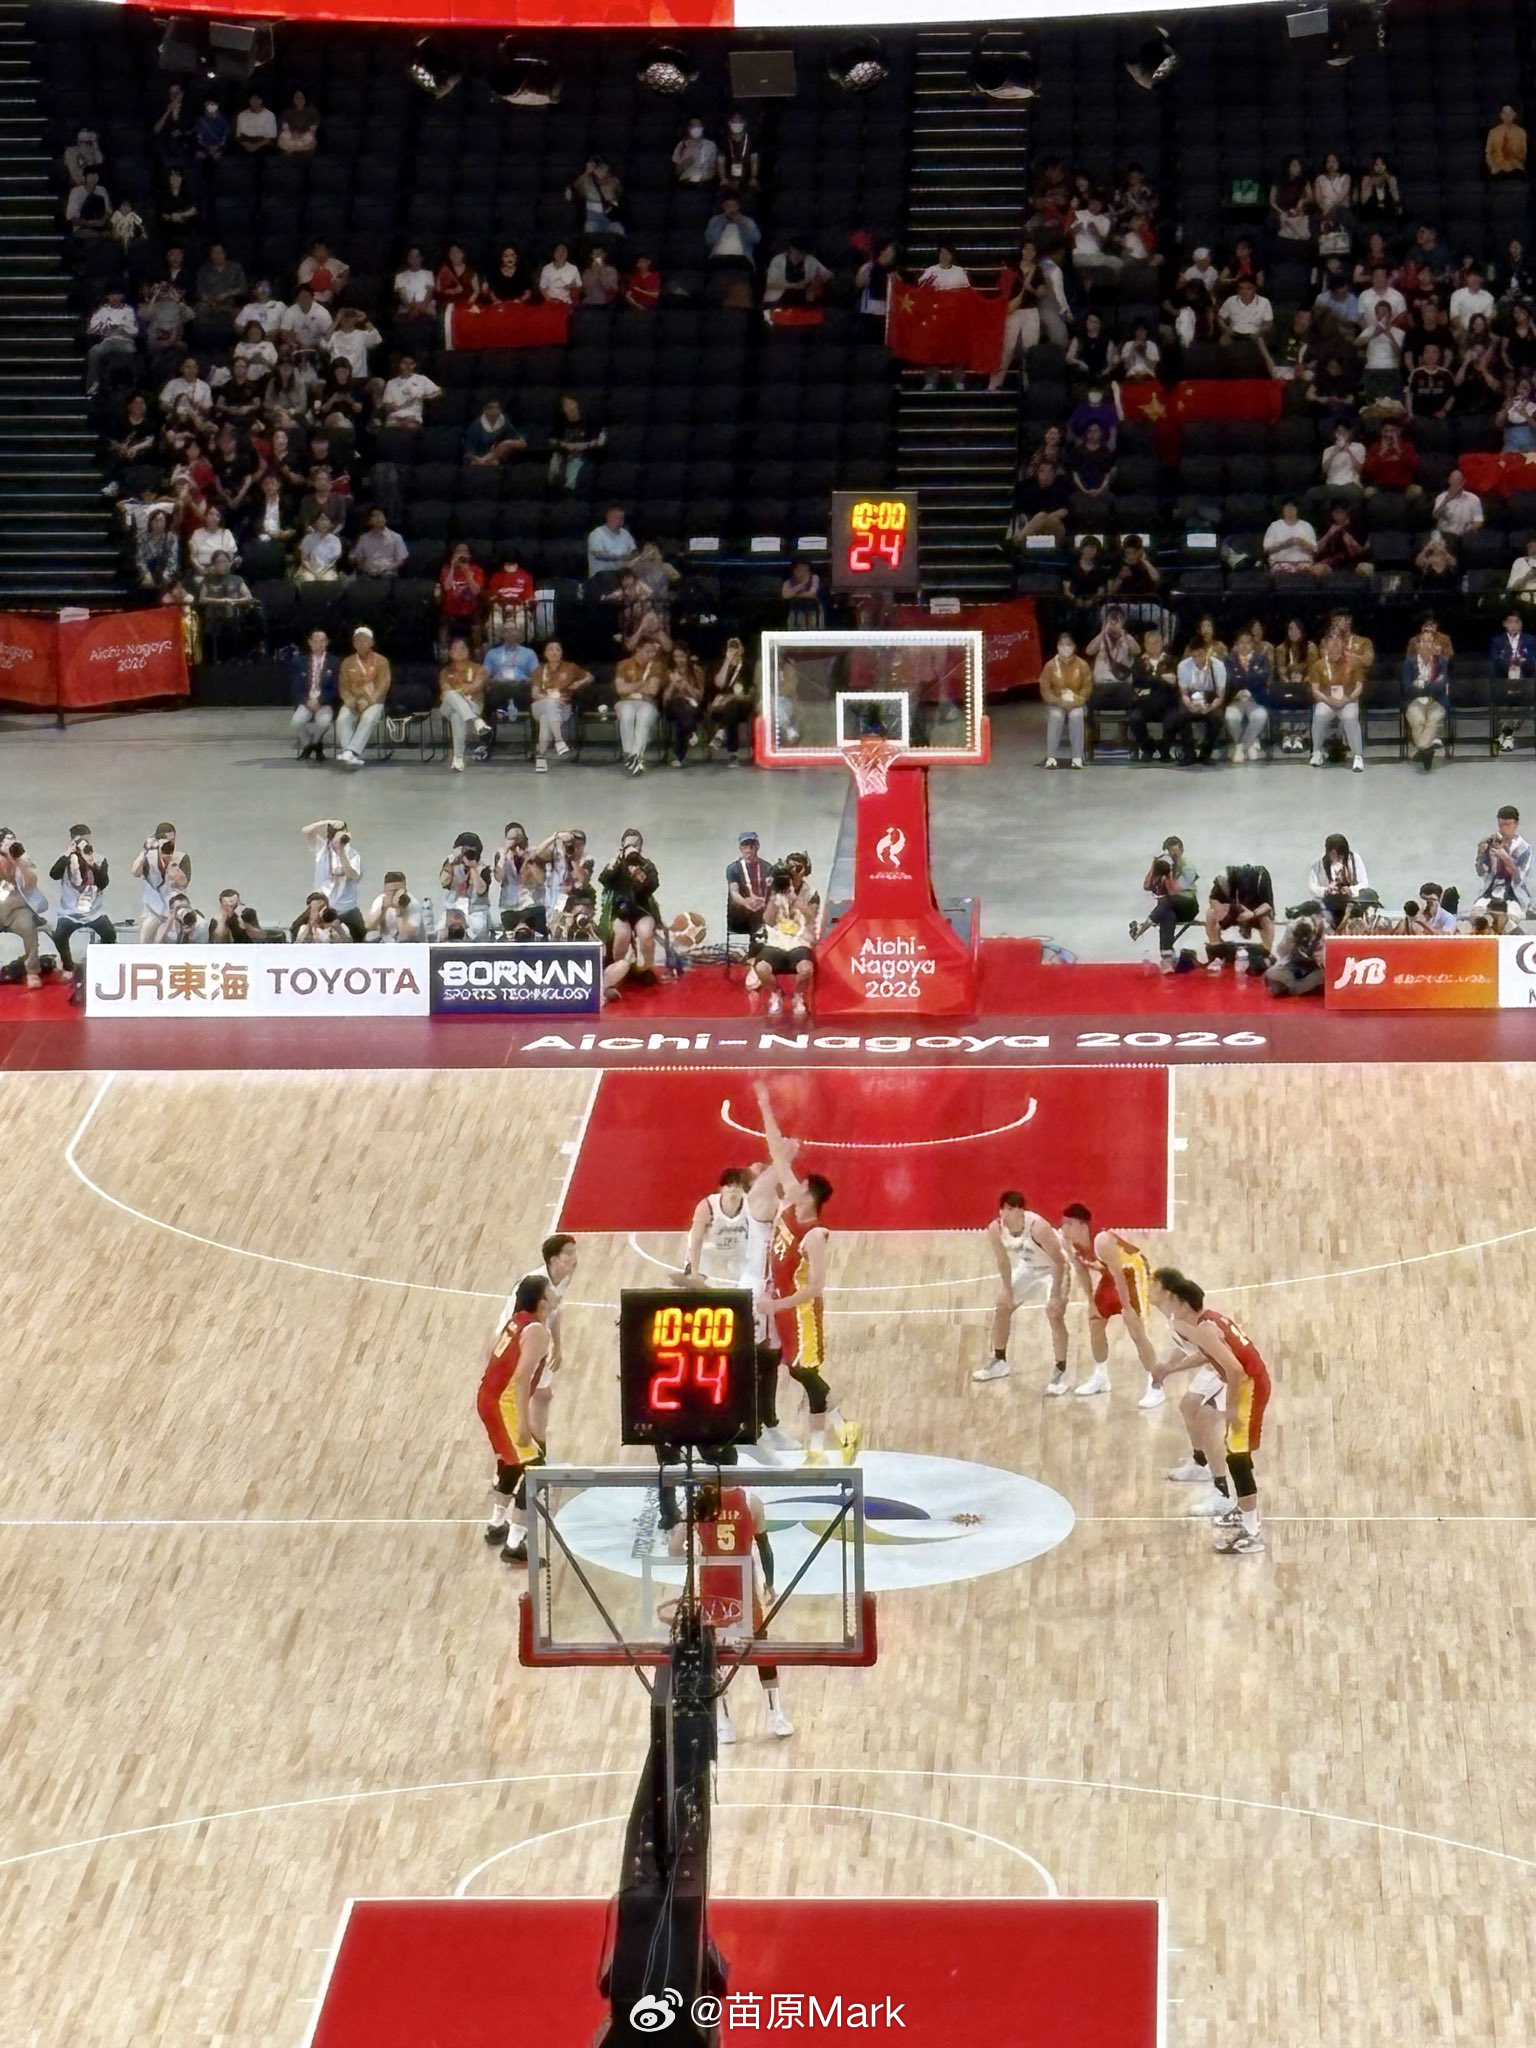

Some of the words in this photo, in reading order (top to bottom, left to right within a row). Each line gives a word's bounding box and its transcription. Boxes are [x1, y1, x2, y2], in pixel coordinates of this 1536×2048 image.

[851, 502, 906, 530] 10:00
[850, 532, 900, 571] 24
[95, 962, 249, 1001] JR東海
[267, 967, 421, 995] TOYOTA
[438, 960, 593, 986] BORNAN
[851, 956, 936, 979] Nagoya
[1334, 956, 1387, 990] JTB
[443, 987, 498, 1001] SPORTS
[500, 987, 592, 1001] TECHNOLOGY
[865, 980, 921, 998] 2026
[1076, 1032, 1267, 1047] 2026
[653, 1307, 734, 1348] 10:00
[651, 1352, 728, 1409] 24
[716, 1523, 736, 1551] 5
